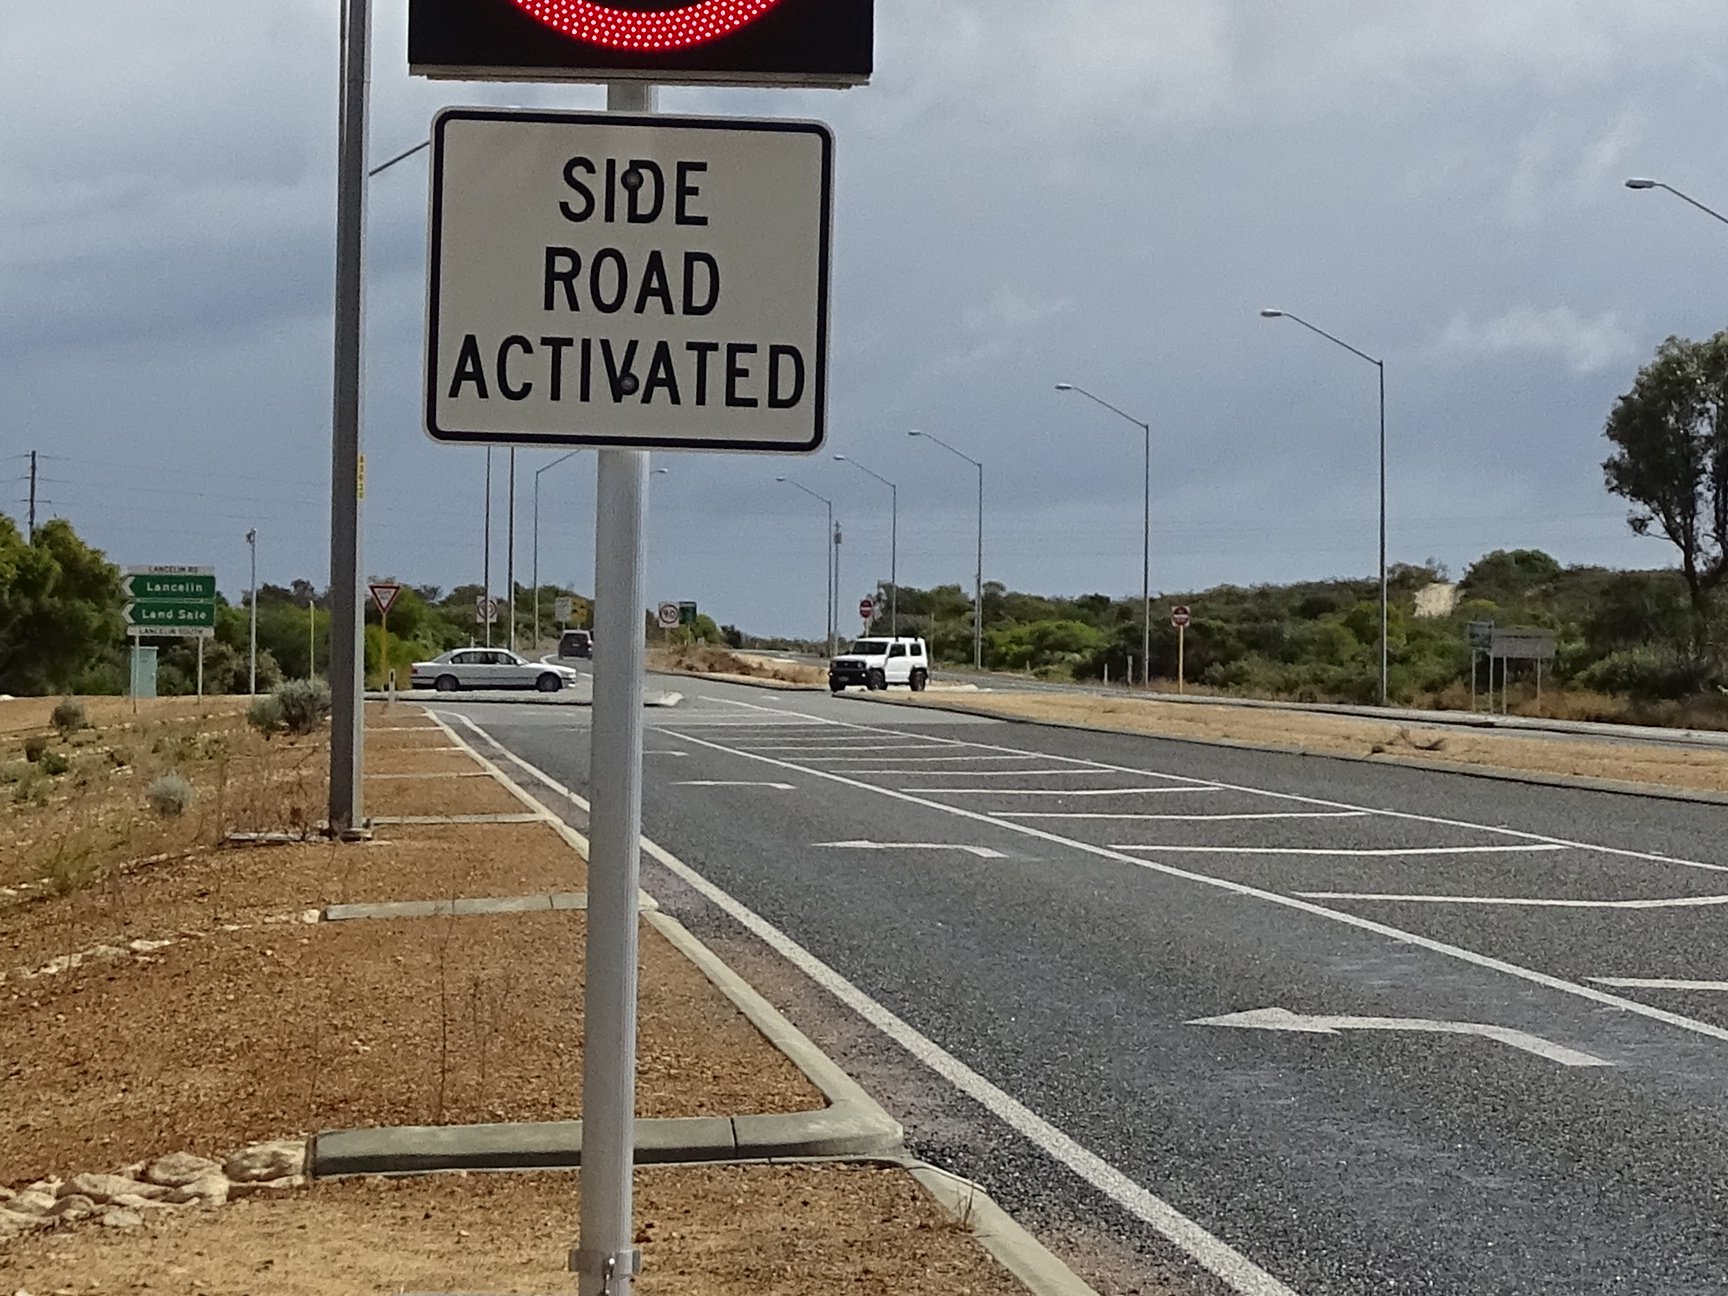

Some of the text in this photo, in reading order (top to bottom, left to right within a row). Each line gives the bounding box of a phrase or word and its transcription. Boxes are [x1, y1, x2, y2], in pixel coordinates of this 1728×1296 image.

[558, 156, 709, 227] SIDE
[543, 247, 720, 317] ROAD
[447, 333, 806, 410] ACTIVATED
[142, 609, 207, 620] Land Sale
[146, 582, 203, 592] Lancelin
